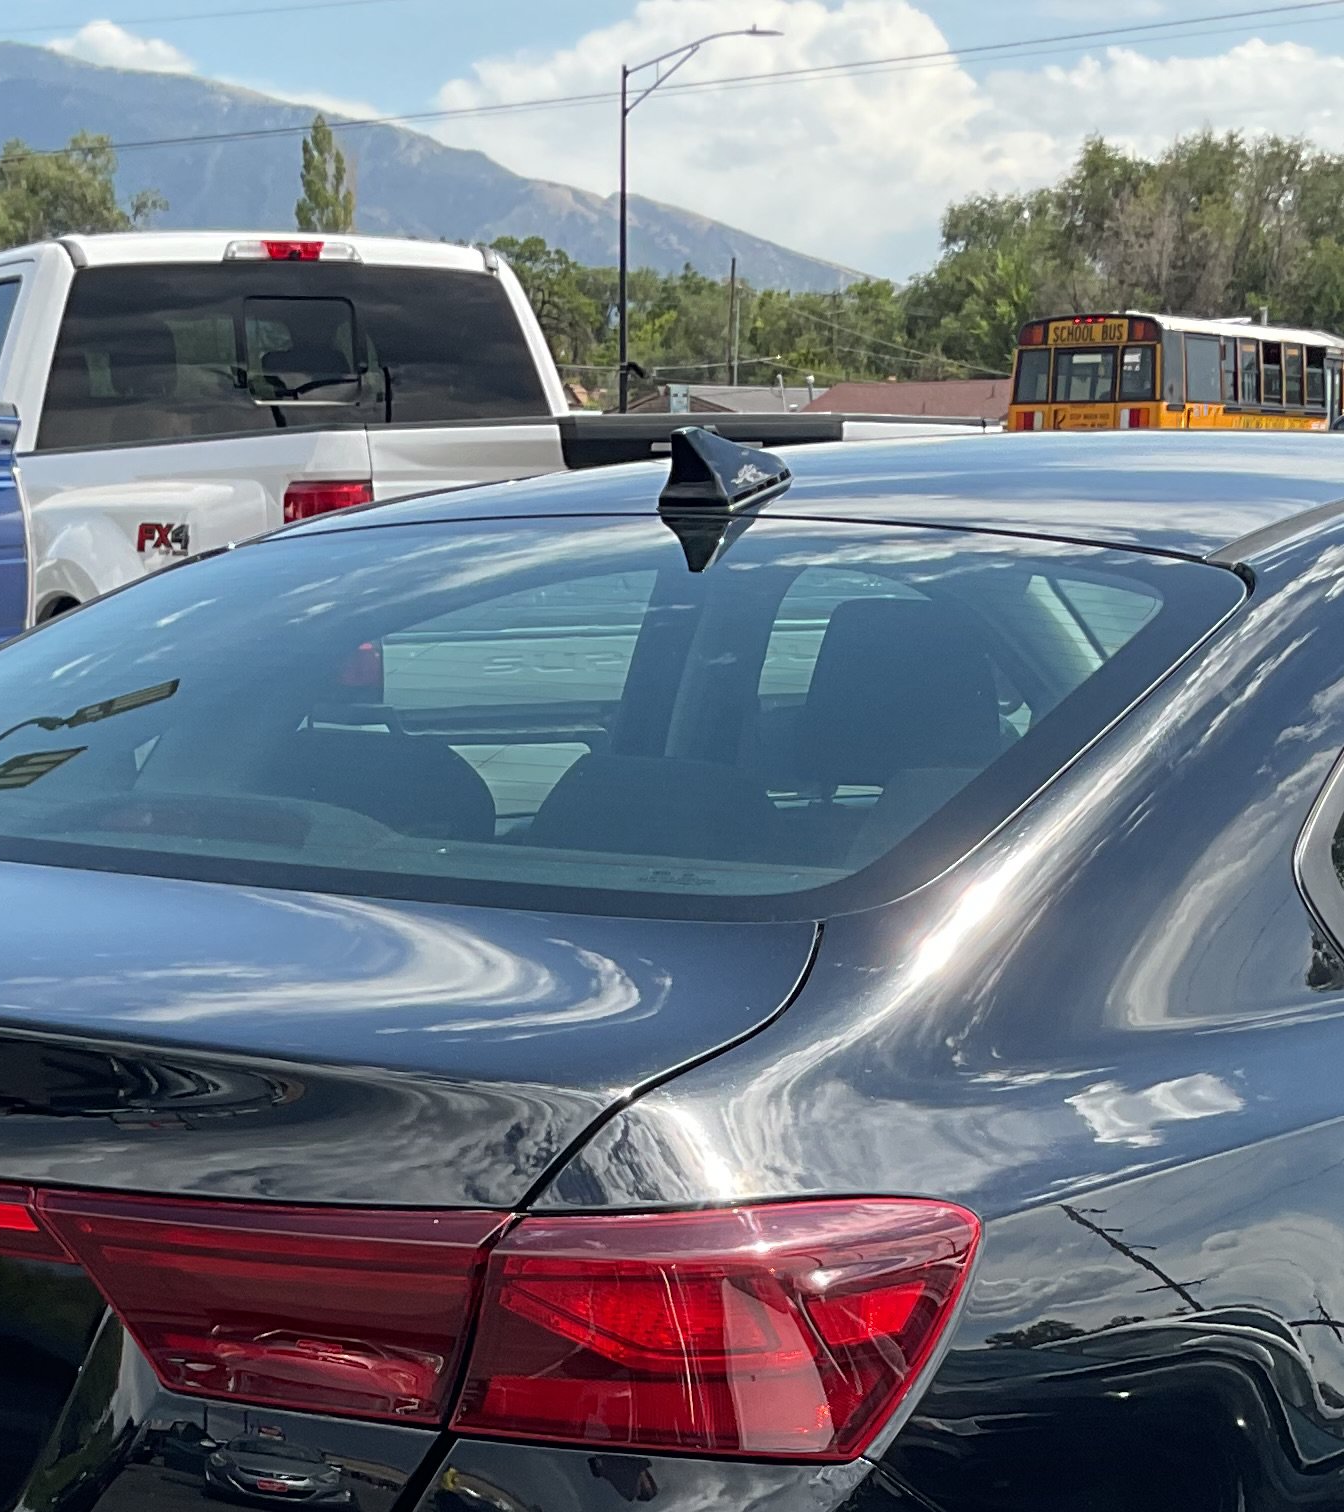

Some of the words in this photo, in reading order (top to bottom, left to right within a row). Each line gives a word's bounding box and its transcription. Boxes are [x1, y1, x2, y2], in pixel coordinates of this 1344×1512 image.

[1052, 325, 1096, 342] SCHOOL
[1101, 323, 1124, 340] BUS
[136, 522, 190, 553] FX4
